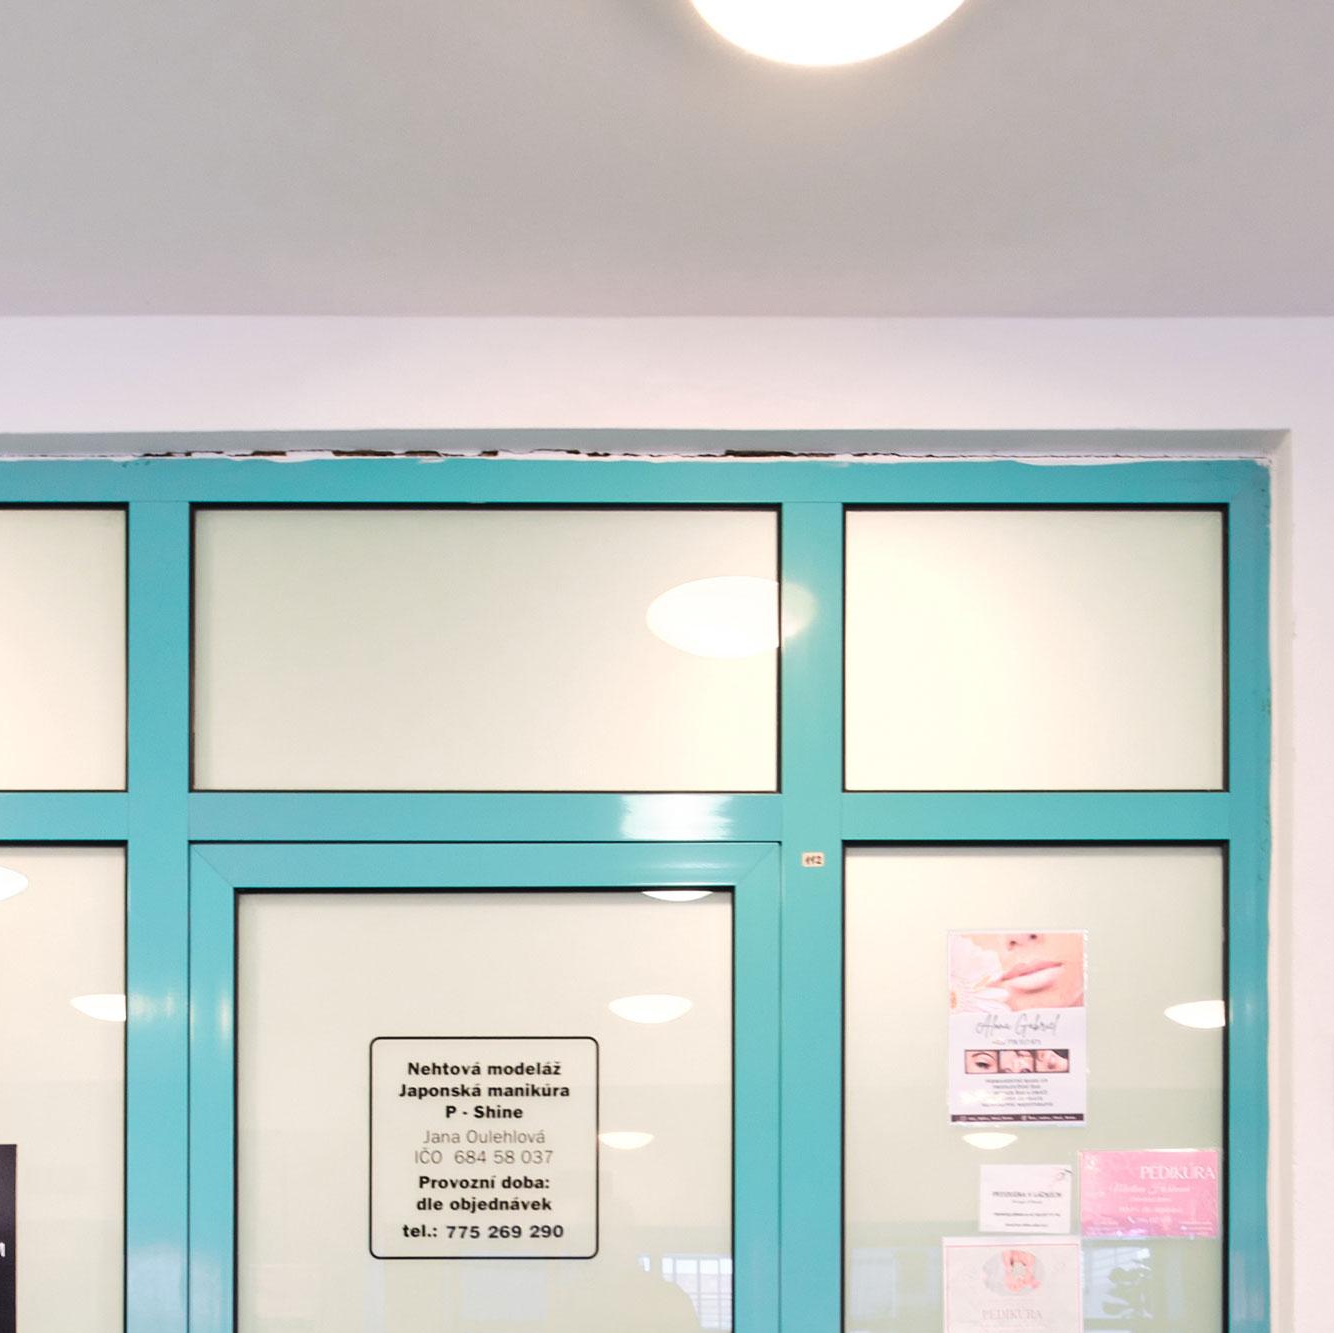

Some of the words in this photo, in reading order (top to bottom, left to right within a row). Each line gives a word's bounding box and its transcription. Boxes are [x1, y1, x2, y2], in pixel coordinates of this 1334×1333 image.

[407, 1061, 482, 1076] Nehtová
[487, 1061, 562, 1076] modeláž
[398, 1083, 482, 1100] Japonská
[487, 1083, 571, 1098] manikúra
[445, 1105, 457, 1119] P
[473, 1104, 524, 1119] Shine
[422, 1130, 461, 1145] Jana
[466, 1129, 547, 1145] Oulehlová
[413, 1147, 444, 1165] IČO
[453, 1150, 487, 1165] 684
[493, 1150, 516, 1165] 58
[520, 1150, 554, 1165] 037
[418, 1175, 496, 1190] Provozní
[501, 1175, 551, 1190] doba:
[416, 1197, 445, 1212] dle
[449, 1197, 553, 1214] objednávek
[401, 1224, 439, 1239] tel.:
[446, 1225, 482, 1240] 775
[487, 1225, 523, 1239] 269
[529, 1224, 565, 1239] 290
